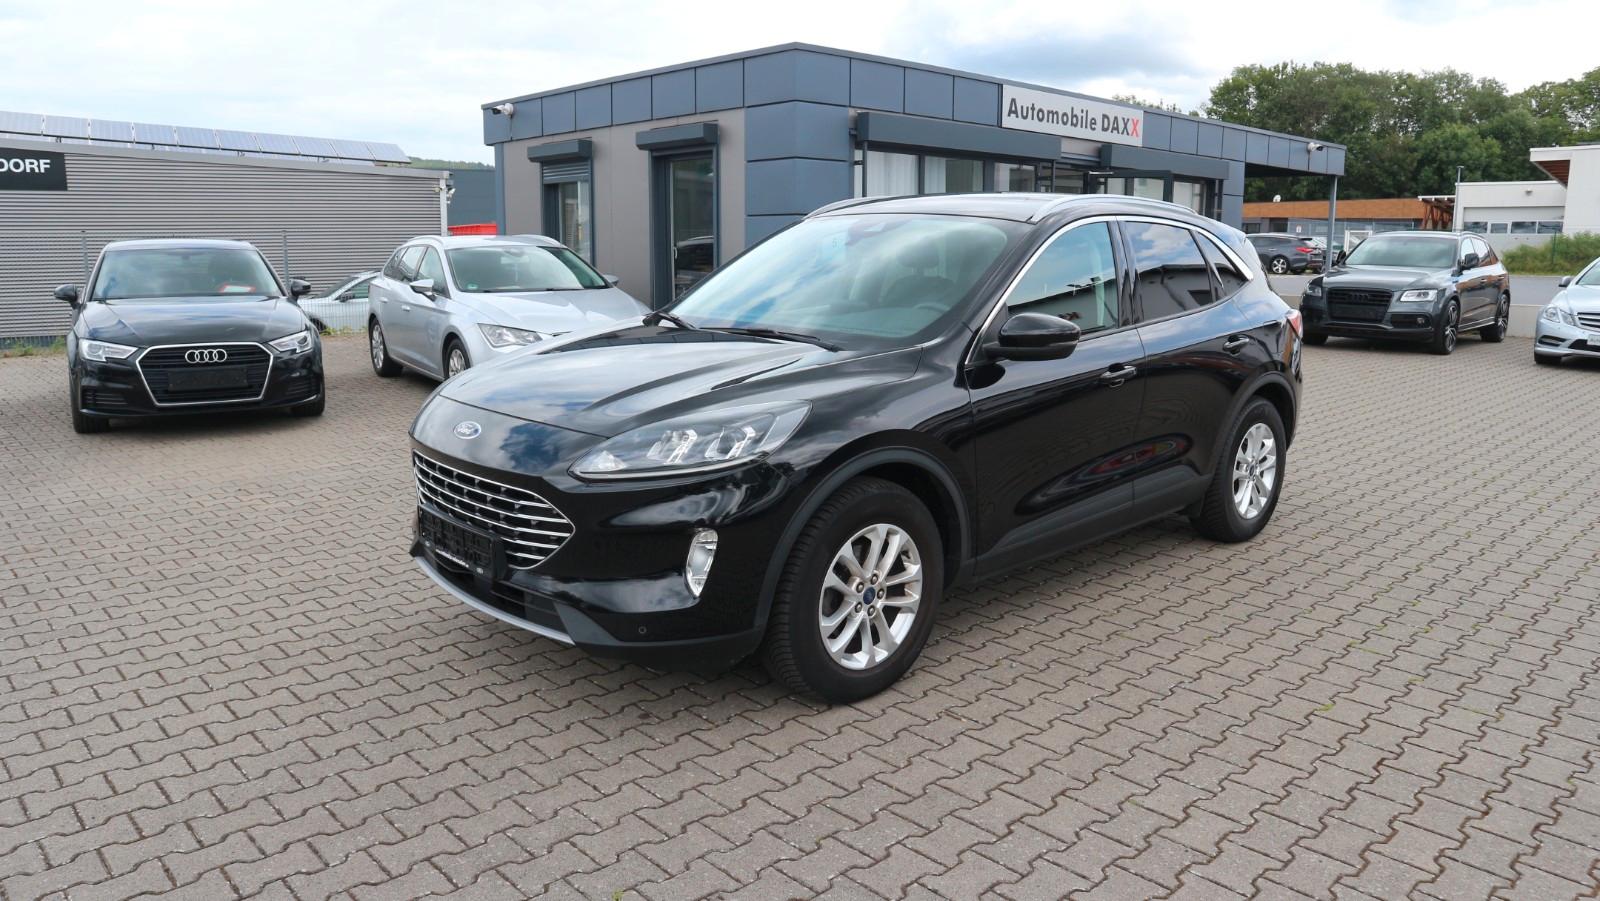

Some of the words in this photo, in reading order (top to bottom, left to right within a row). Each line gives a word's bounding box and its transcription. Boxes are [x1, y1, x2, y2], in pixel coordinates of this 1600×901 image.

[1007, 97, 1097, 131] Automobile
[1101, 113, 1140, 138] DAXX
[0, 158, 51, 173] DORF
